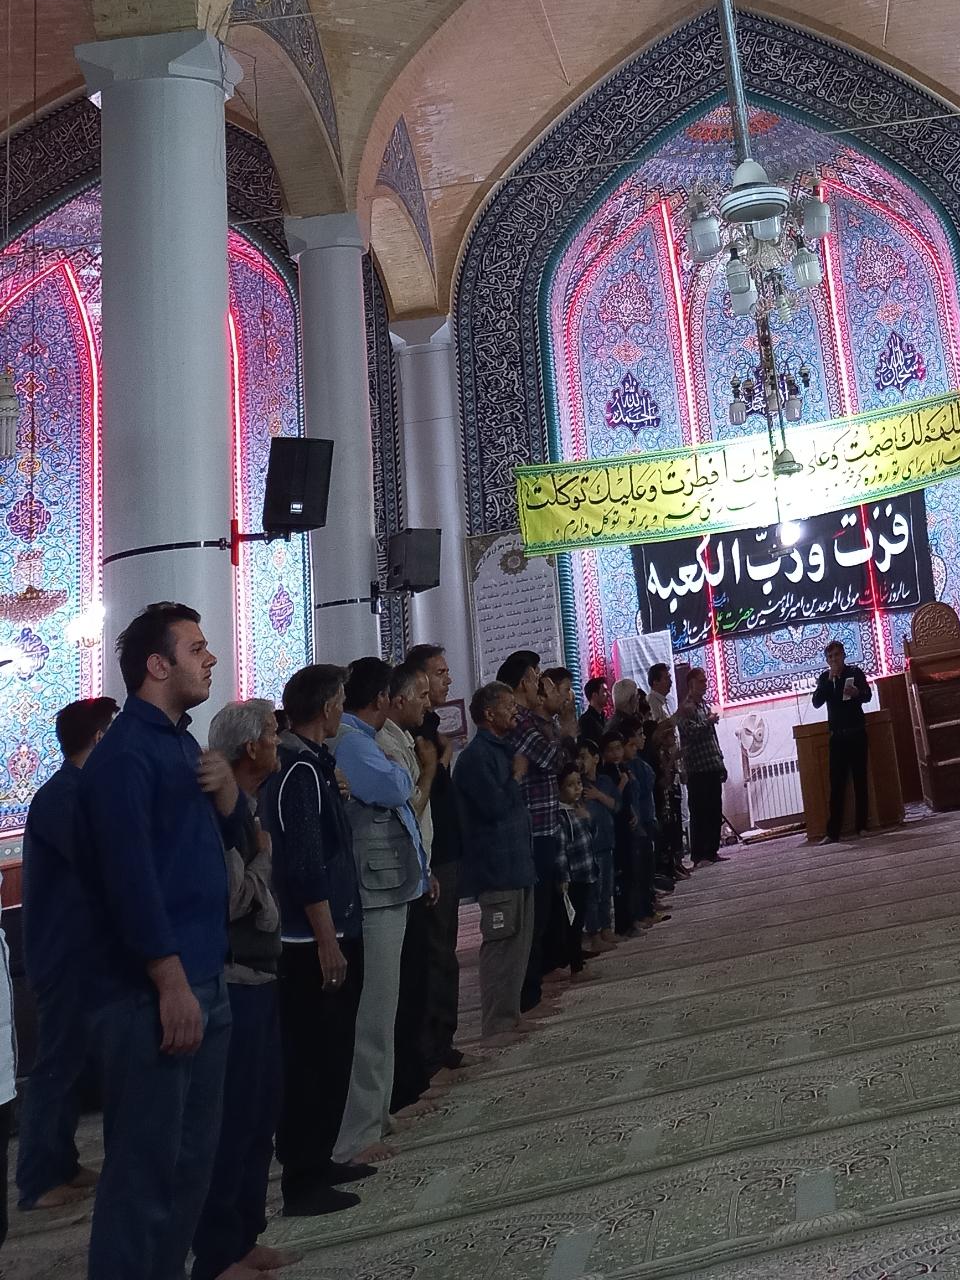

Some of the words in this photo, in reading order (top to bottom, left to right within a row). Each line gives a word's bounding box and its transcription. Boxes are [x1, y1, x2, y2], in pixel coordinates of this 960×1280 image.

[902, 457, 925, 480] برای
[834, 504, 909, 572] فزت
[801, 586, 841, 618] الموحدین
[840, 584, 860, 611] مولی
[888, 581, 910, 604] سالروز
[723, 608, 754, 631] حضرت
